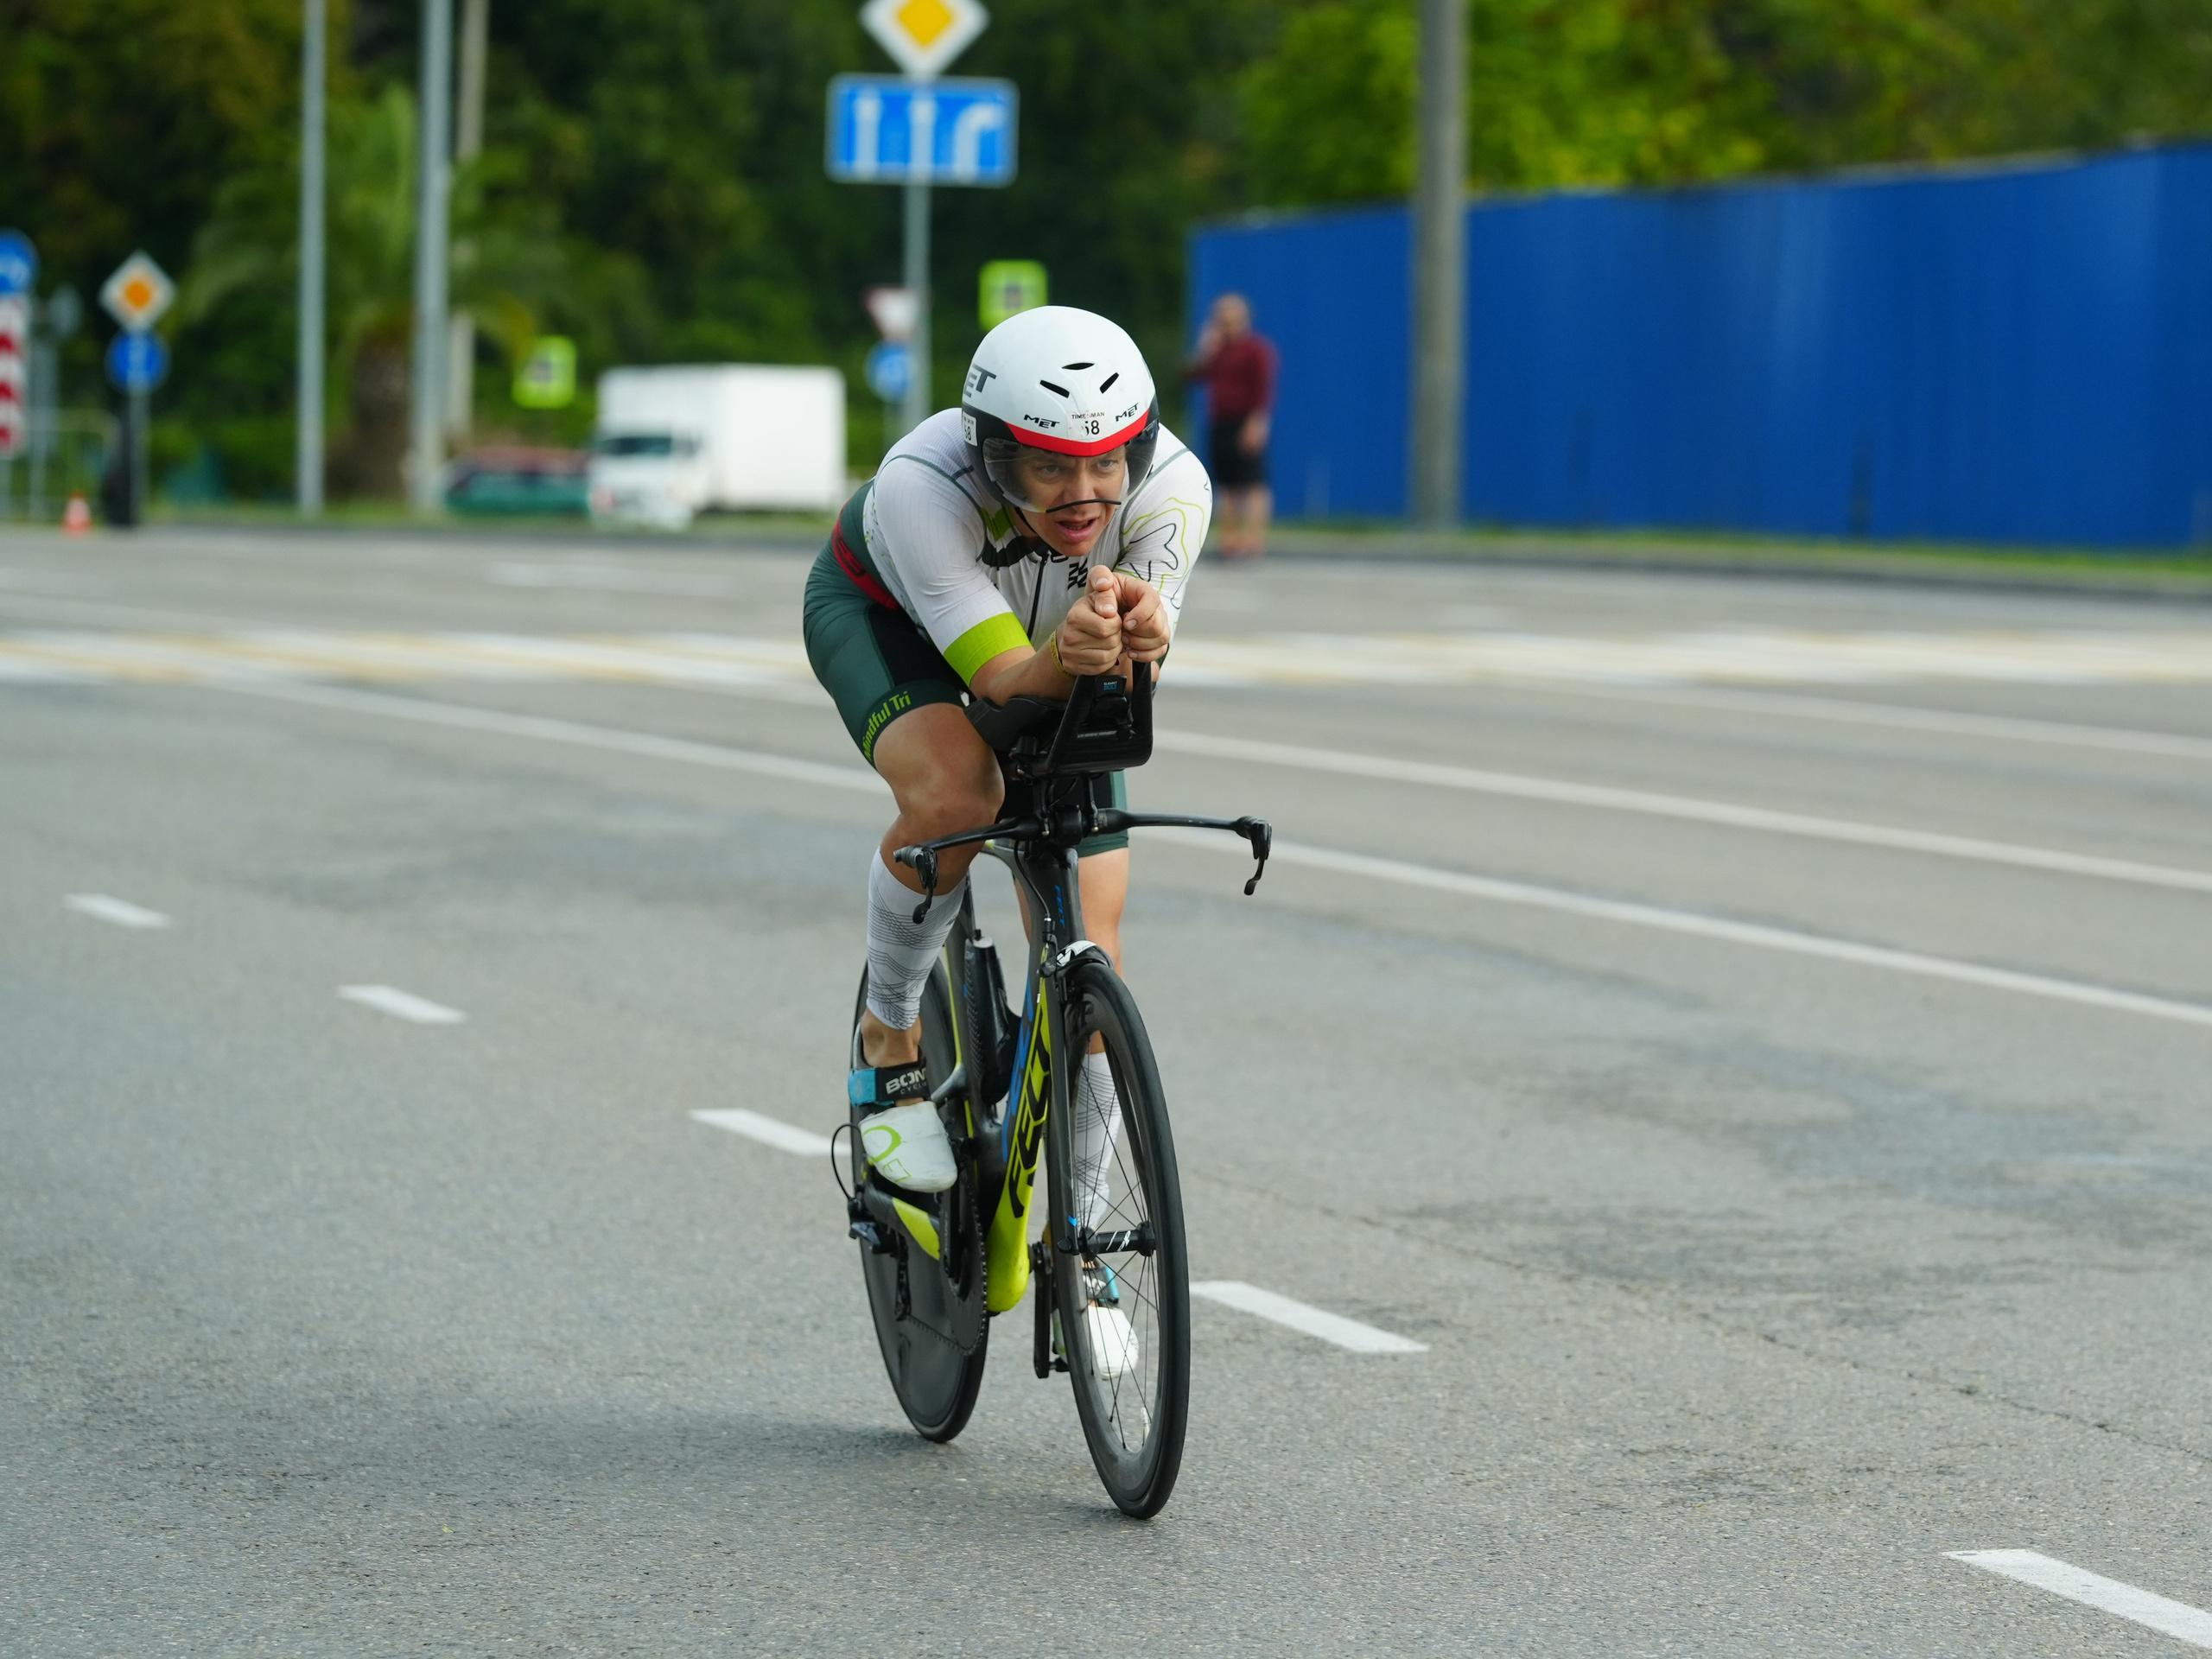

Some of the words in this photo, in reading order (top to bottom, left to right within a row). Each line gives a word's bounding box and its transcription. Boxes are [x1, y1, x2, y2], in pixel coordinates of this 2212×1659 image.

[1023, 414, 1060, 429] MET
[1116, 403, 1139, 423] MET
[889, 690, 912, 711] Tri
[1008, 1002, 1052, 1219] FELT
